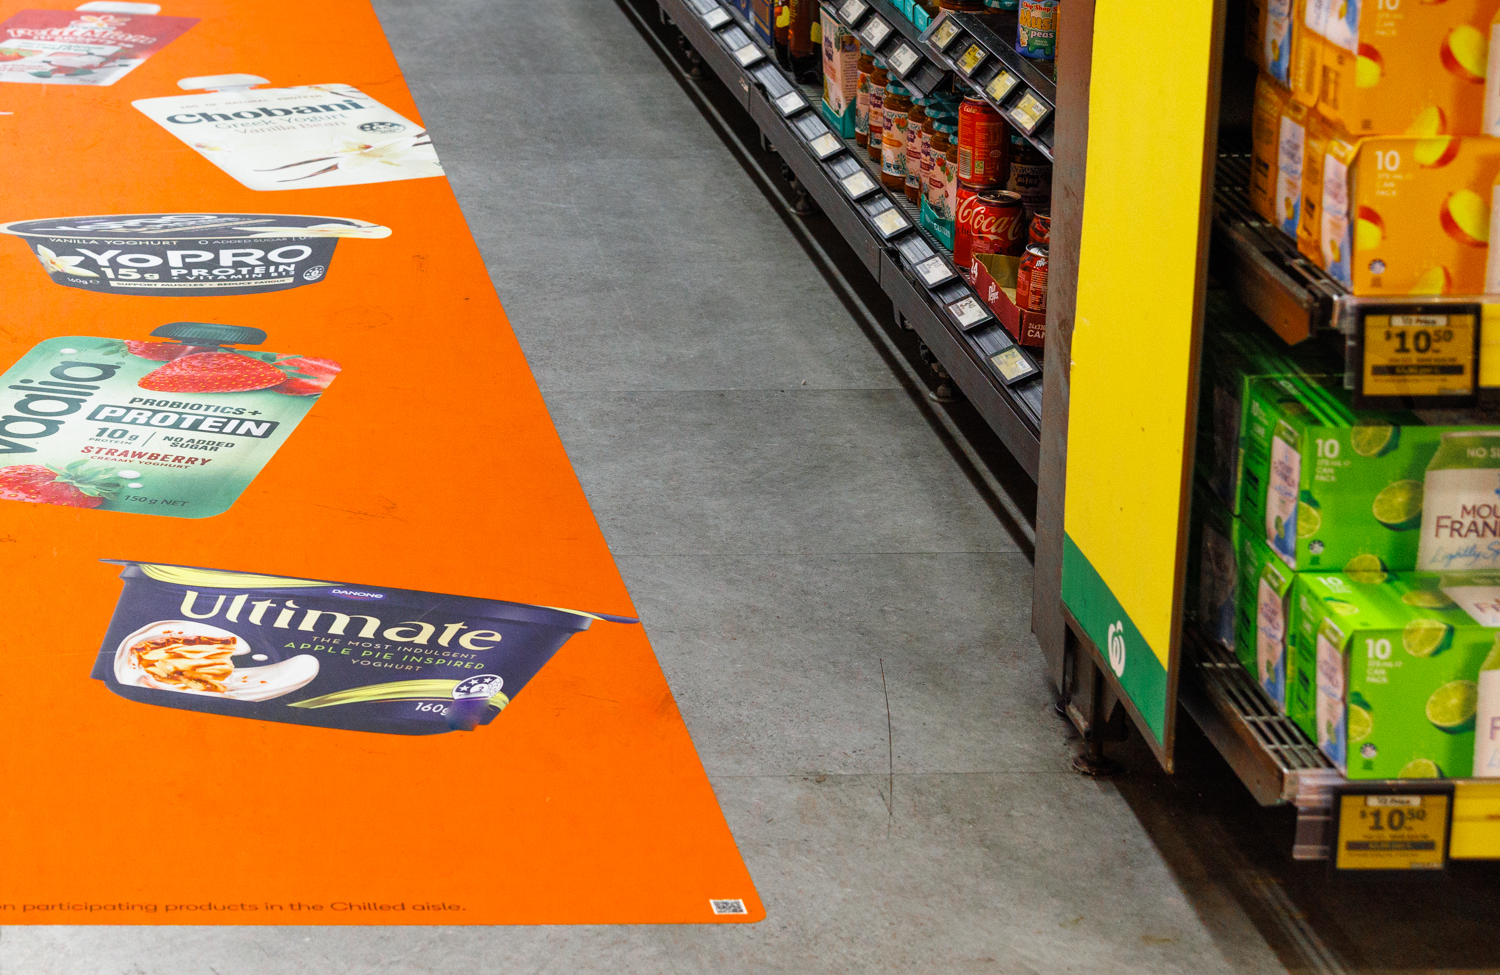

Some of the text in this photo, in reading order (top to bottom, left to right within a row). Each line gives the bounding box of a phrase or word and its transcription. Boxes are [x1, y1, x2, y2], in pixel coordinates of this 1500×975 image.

[1031, 28, 1055, 39] peas
[166, 99, 367, 125] Chobani
[1375, 150, 1400, 172] 10
[49, 237, 100, 245] VANILLA
[104, 239, 179, 247] YOGHURT
[75, 245, 313, 268] YoPRO
[100, 264, 296, 281] 15g PROTEIN
[184, 273, 262, 281] VITAMIN
[94, 406, 271, 437] PROTEIN
[88, 437, 132, 445] PROTEIN
[95, 427, 139, 441] 10g
[163, 435, 235, 448] NO ADDED
[170, 442, 220, 452] SUGAR
[1315, 438, 1340, 459] 10
[80, 445, 212, 466] STRAWBERRY
[90, 455, 191, 469] CREAMY YOGHURT
[124, 494, 190, 507] 150 NET
[331, 588, 384, 599] DANONE
[180, 590, 502, 651] Ultimate
[311, 635, 478, 660] THE MOST INDULGENT
[1365, 638, 1391, 660] 10
[284, 641, 486, 671] APPLE PIE INSPIRED
[351, 658, 423, 672] YOGHURT
[22, 900, 158, 915] participating
[164, 900, 258, 915] products
[264, 900, 283, 911] in
[288, 900, 324, 912] the
[329, 900, 406, 912] Chilled
[411, 900, 466, 912] aisle.
